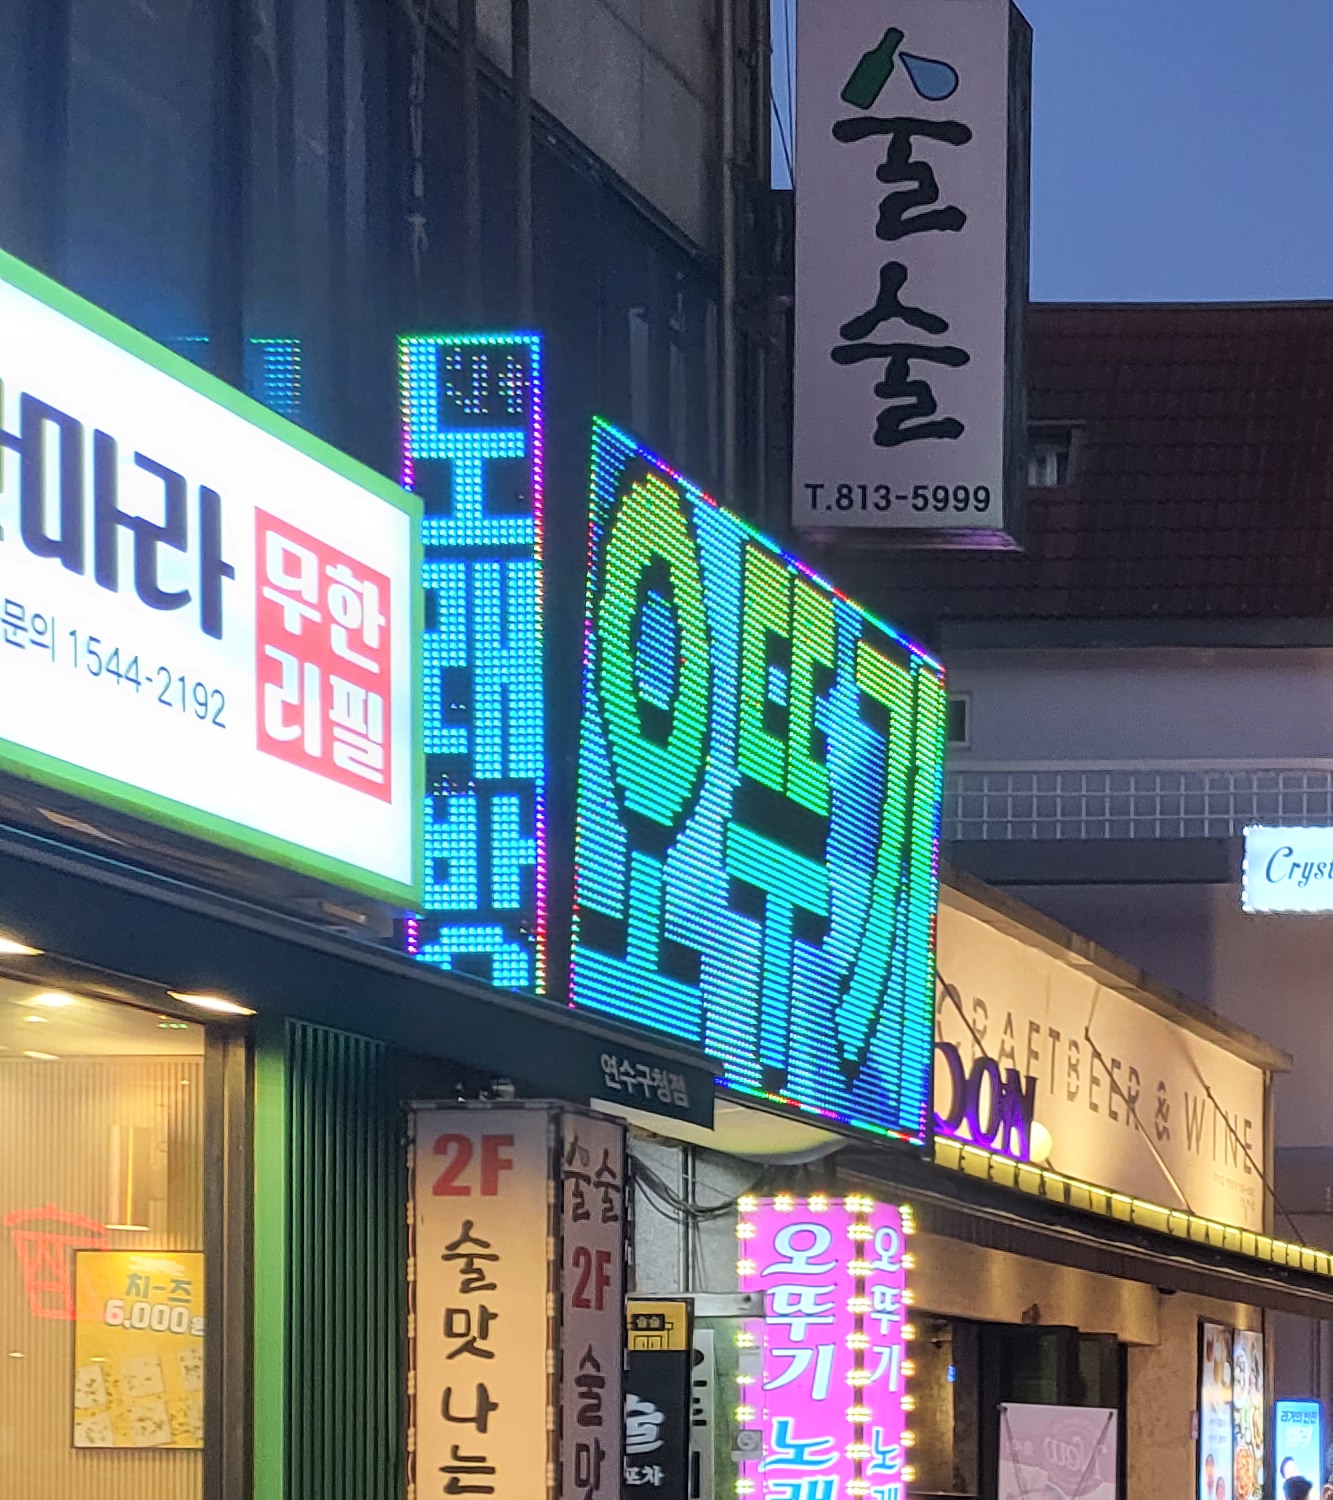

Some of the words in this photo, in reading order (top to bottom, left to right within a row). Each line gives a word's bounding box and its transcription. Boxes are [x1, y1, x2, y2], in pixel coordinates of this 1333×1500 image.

[0, 376, 235, 640] 마라
[804, 484, 991, 512] T.813-5999
[0, 598, 56, 663] 문의
[69, 629, 226, 729] 1544-2192
[260, 530, 386, 674] 무한
[262, 644, 384, 784] 리필
[574, 470, 942, 1125] 오뚜기
[600, 1053, 690, 1109] 연수구청점
[1184, 1090, 1254, 1176] WINE
[431, 1132, 515, 1197] 2F
[562, 1135, 621, 1222] 술술
[571, 1246, 612, 1311] 2F
[759, 1222, 839, 1401] 오뚜기
[868, 1226, 902, 1392] 오뚜기
